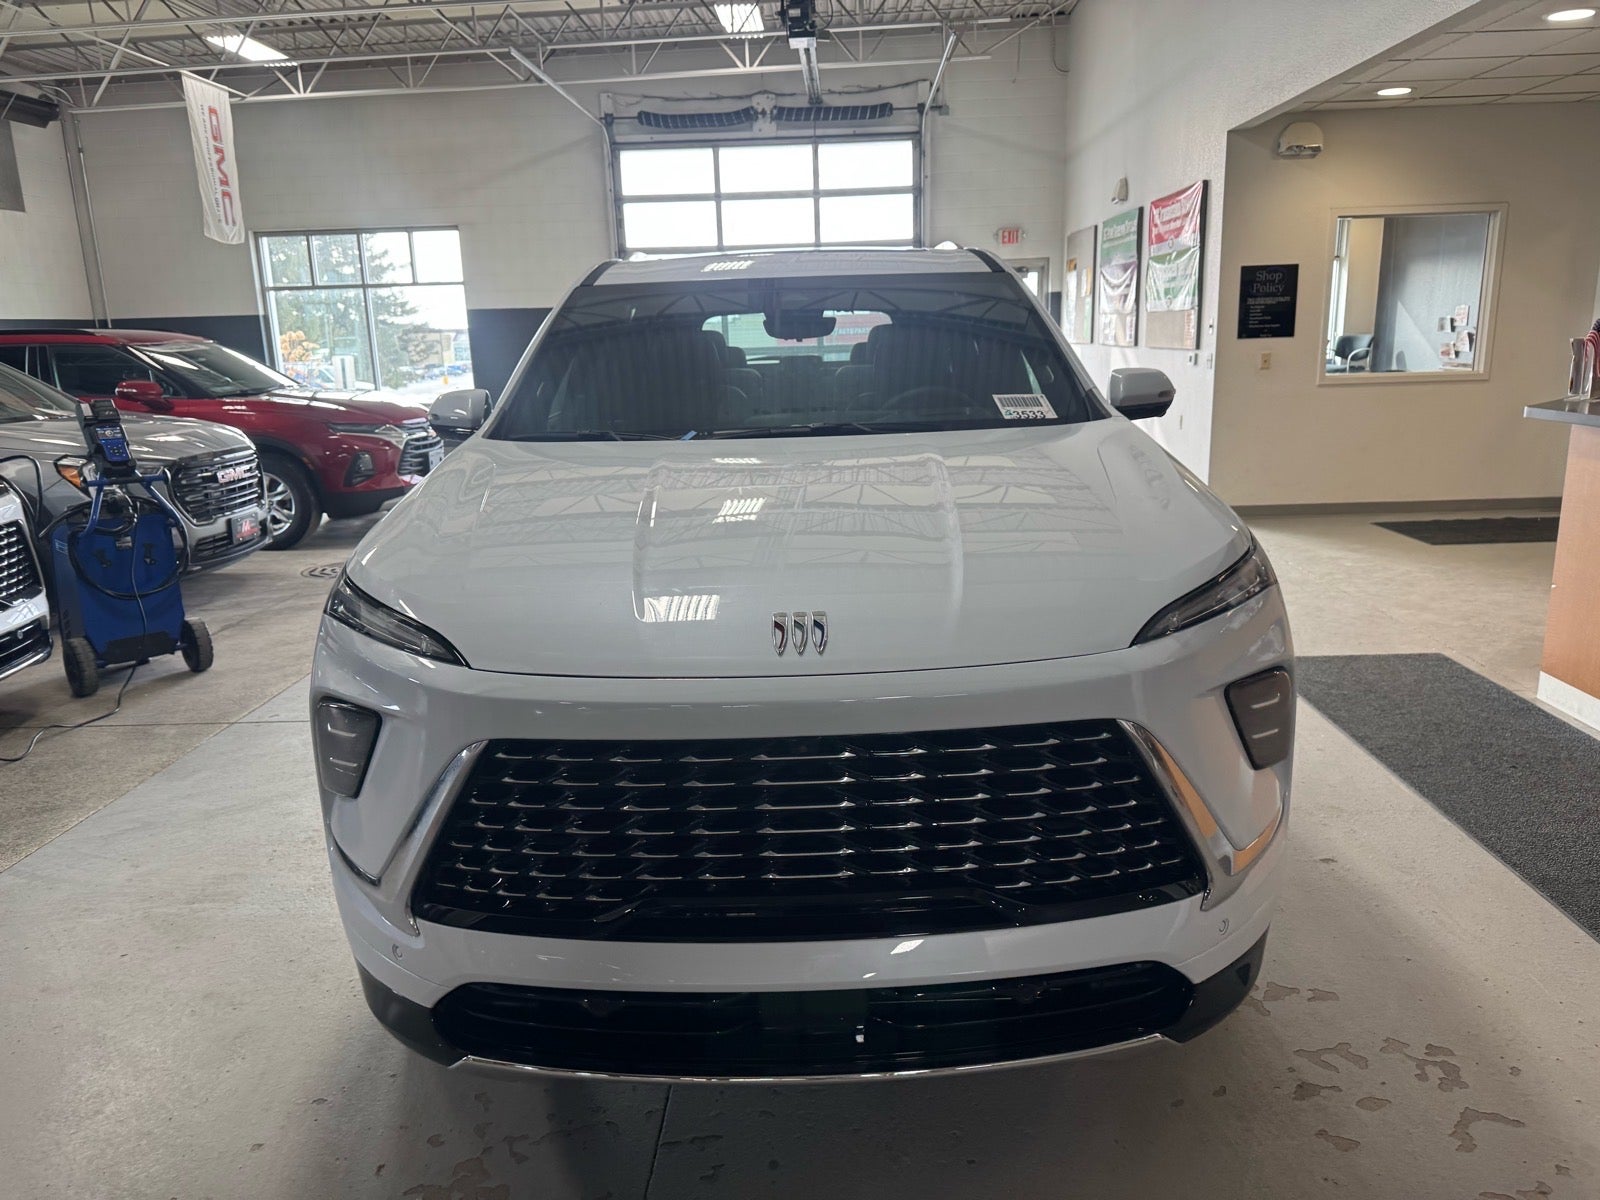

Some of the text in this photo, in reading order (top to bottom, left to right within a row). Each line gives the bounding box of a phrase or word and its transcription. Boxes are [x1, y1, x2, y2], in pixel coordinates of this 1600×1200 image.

[208, 106, 236, 226] GMC
[1001, 229, 1019, 244] EXIT
[1256, 270, 1283, 283] Shop
[1252, 283, 1285, 295] Policy
[1013, 410, 1047, 420] 3533
[217, 466, 254, 483] GMC
